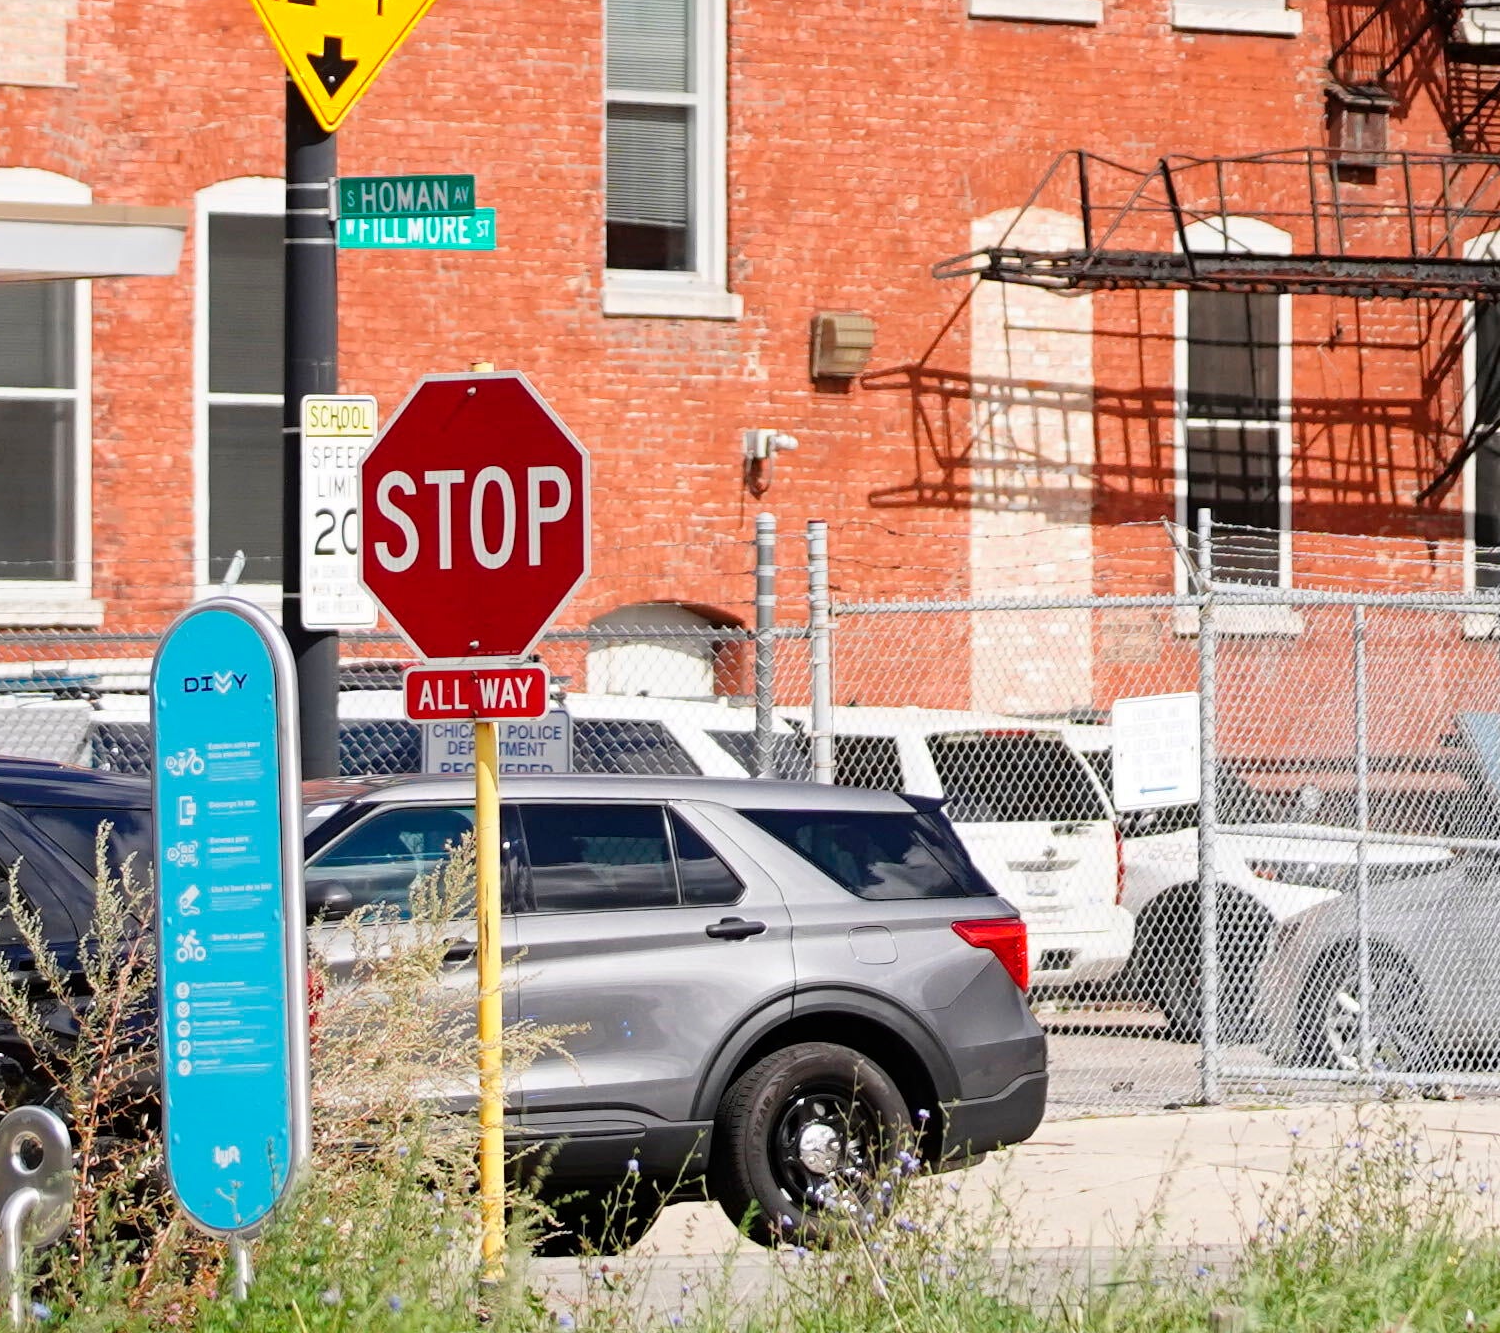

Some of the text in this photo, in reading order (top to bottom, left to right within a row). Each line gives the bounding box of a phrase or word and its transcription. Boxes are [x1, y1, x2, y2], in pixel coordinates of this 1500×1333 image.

[347, 181, 470, 213] S HOMAN AV
[359, 215, 472, 245] FILLMORE
[476, 219, 491, 238] ST
[310, 405, 370, 430] SCHOOL
[317, 475, 358, 498] LIMI
[374, 465, 572, 573] STOP
[418, 675, 533, 711] ALL WAY
[433, 724, 563, 741] CHICA POLICE
[447, 741, 547, 757] DEPTMENT
